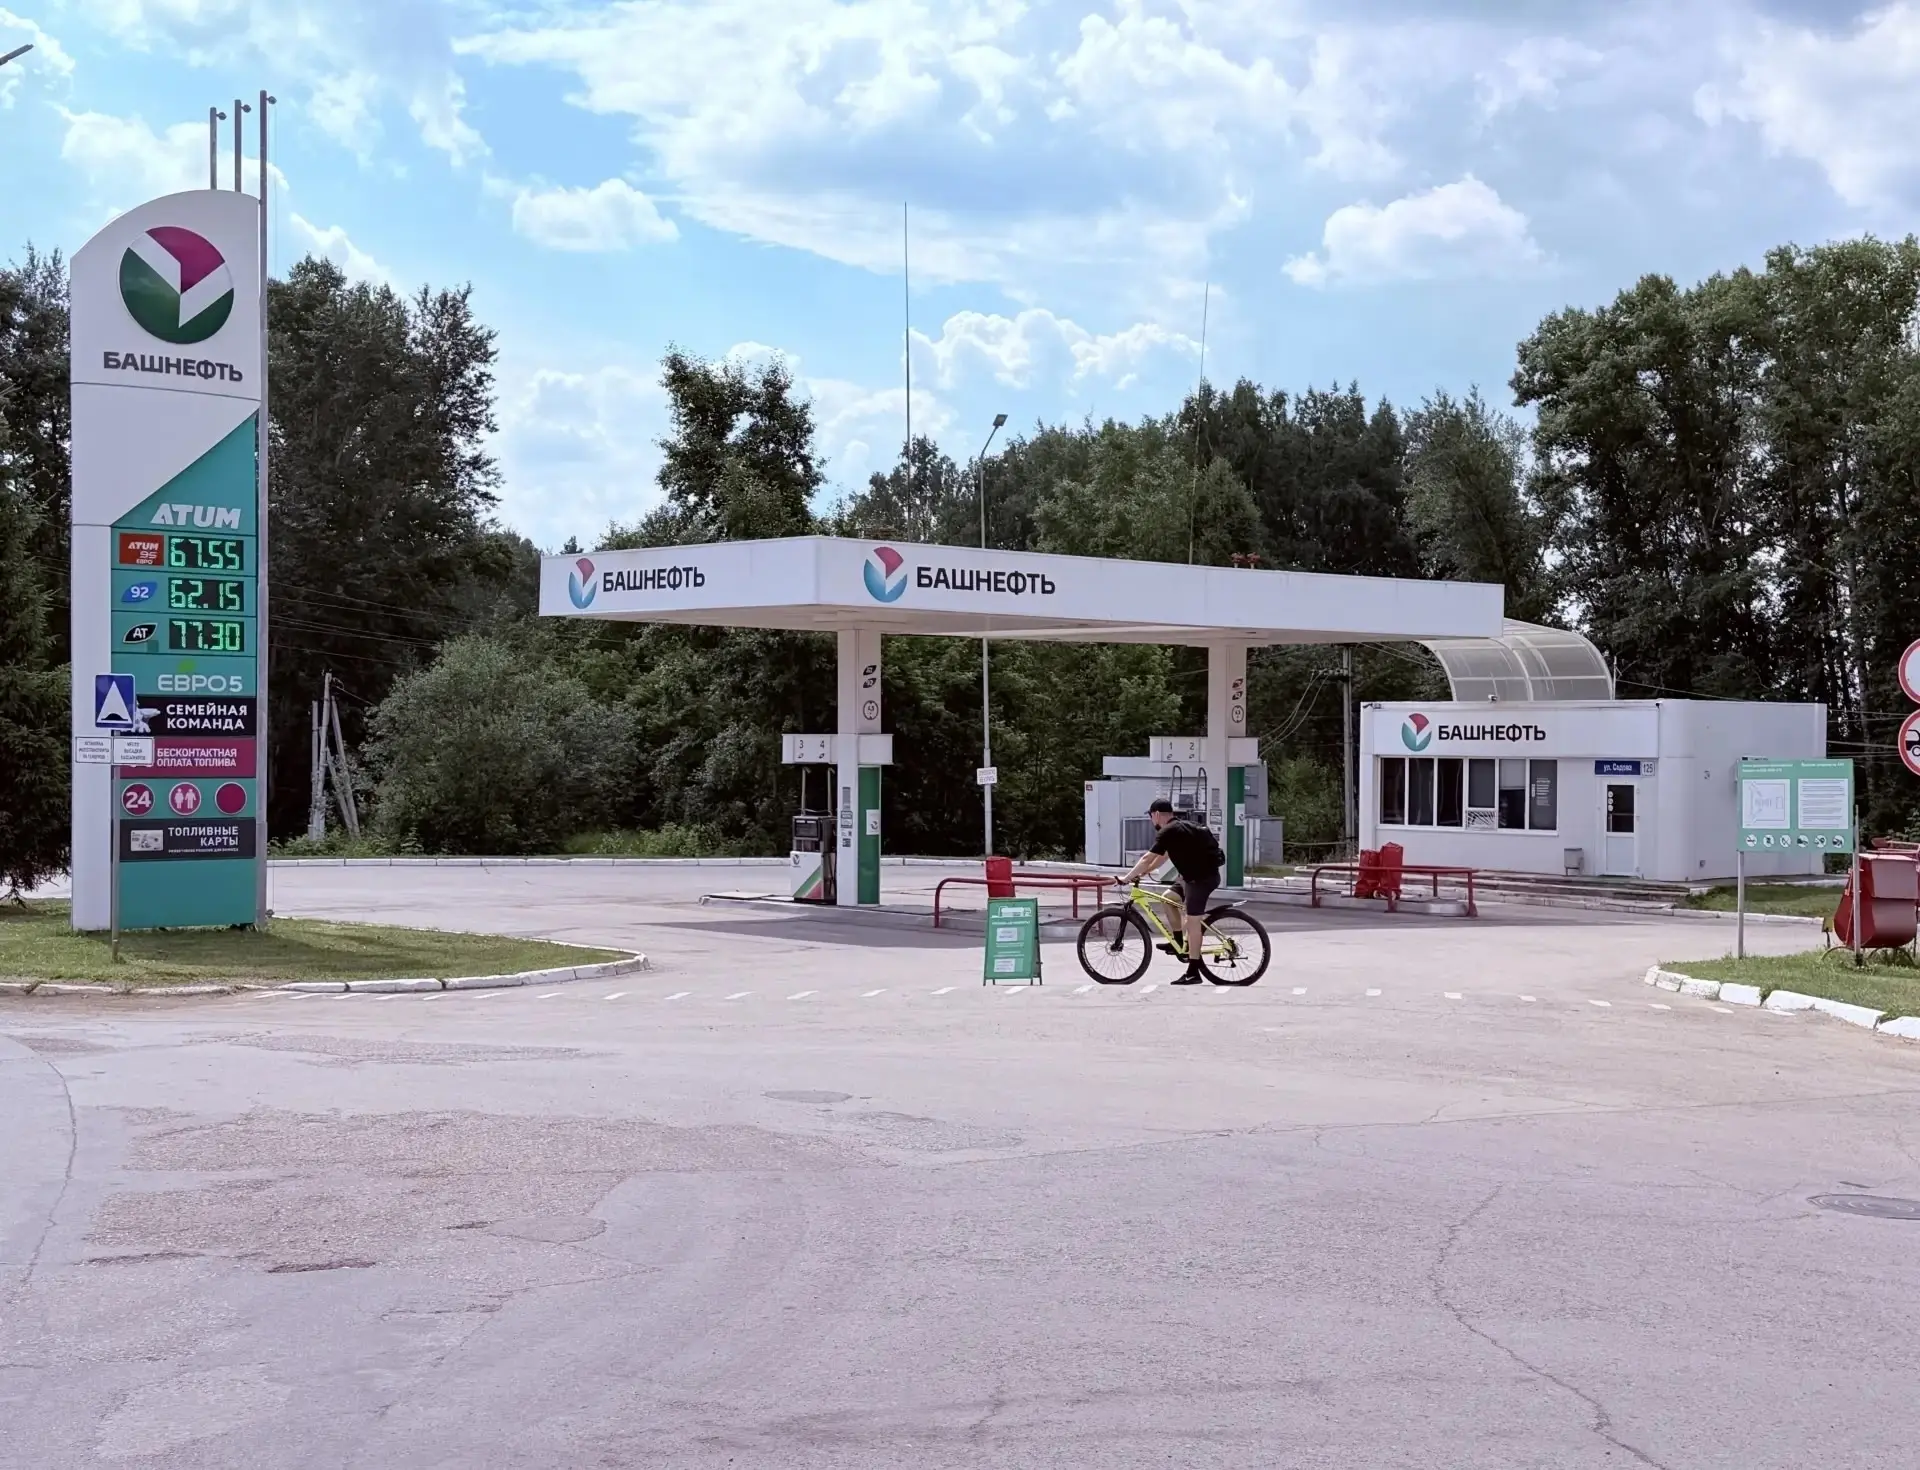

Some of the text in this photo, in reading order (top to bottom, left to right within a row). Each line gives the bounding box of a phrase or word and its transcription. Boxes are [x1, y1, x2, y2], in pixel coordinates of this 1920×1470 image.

[103, 351, 243, 382] БАШНЕФТЬ
[150, 503, 241, 530] ATUM
[140, 550, 158, 559] 95
[171, 538, 240, 570] 67.55
[603, 565, 705, 592] БАШНЕФТЬ
[916, 566, 1056, 596] БАШНЕФТЬ
[130, 586, 149, 598] 92
[171, 579, 241, 611] 62.15
[172, 620, 241, 651] 77.30
[166, 702, 248, 716] СЕМЕЙНАЯ
[167, 717, 245, 731] КОМАНДА
[1438, 724, 1546, 742] БАШНЕФТЬ
[799, 739, 804, 749] 3
[819, 739, 825, 749] 4
[1168, 741, 1173, 750] 1
[1189, 741, 1195, 751] 2
[157, 748, 237, 757] БЕСКОНТАКТНАЯ
[157, 758, 237, 767] ОПЛАТА ТОПЛИВА
[125, 790, 151, 809] 24
[168, 826, 239, 837] ТОПЛИВНЫЕ
[200, 836, 239, 847] КАРТЫ
